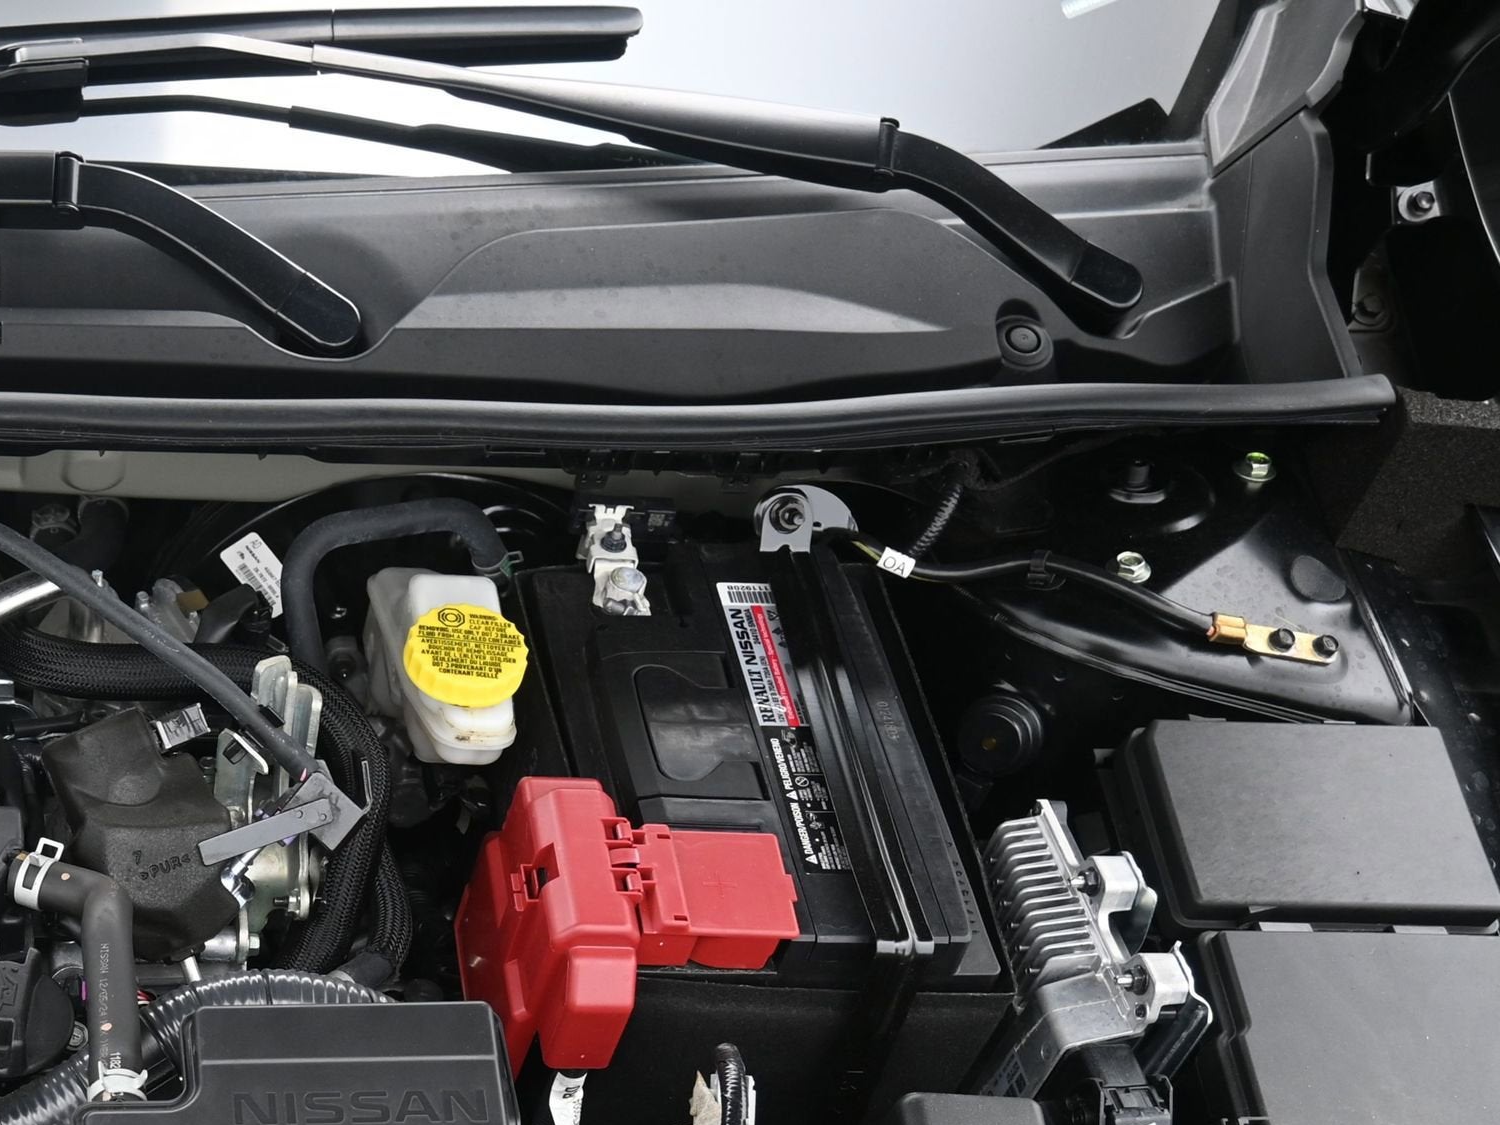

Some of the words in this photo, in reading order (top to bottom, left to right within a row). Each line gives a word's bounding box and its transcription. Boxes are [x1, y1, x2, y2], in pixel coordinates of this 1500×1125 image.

[728, 608, 757, 664] NISSAN
[439, 668, 474, 676] CONTENANT
[747, 669, 776, 722] RENAULT
[101, 943, 109, 973] NISSAN
